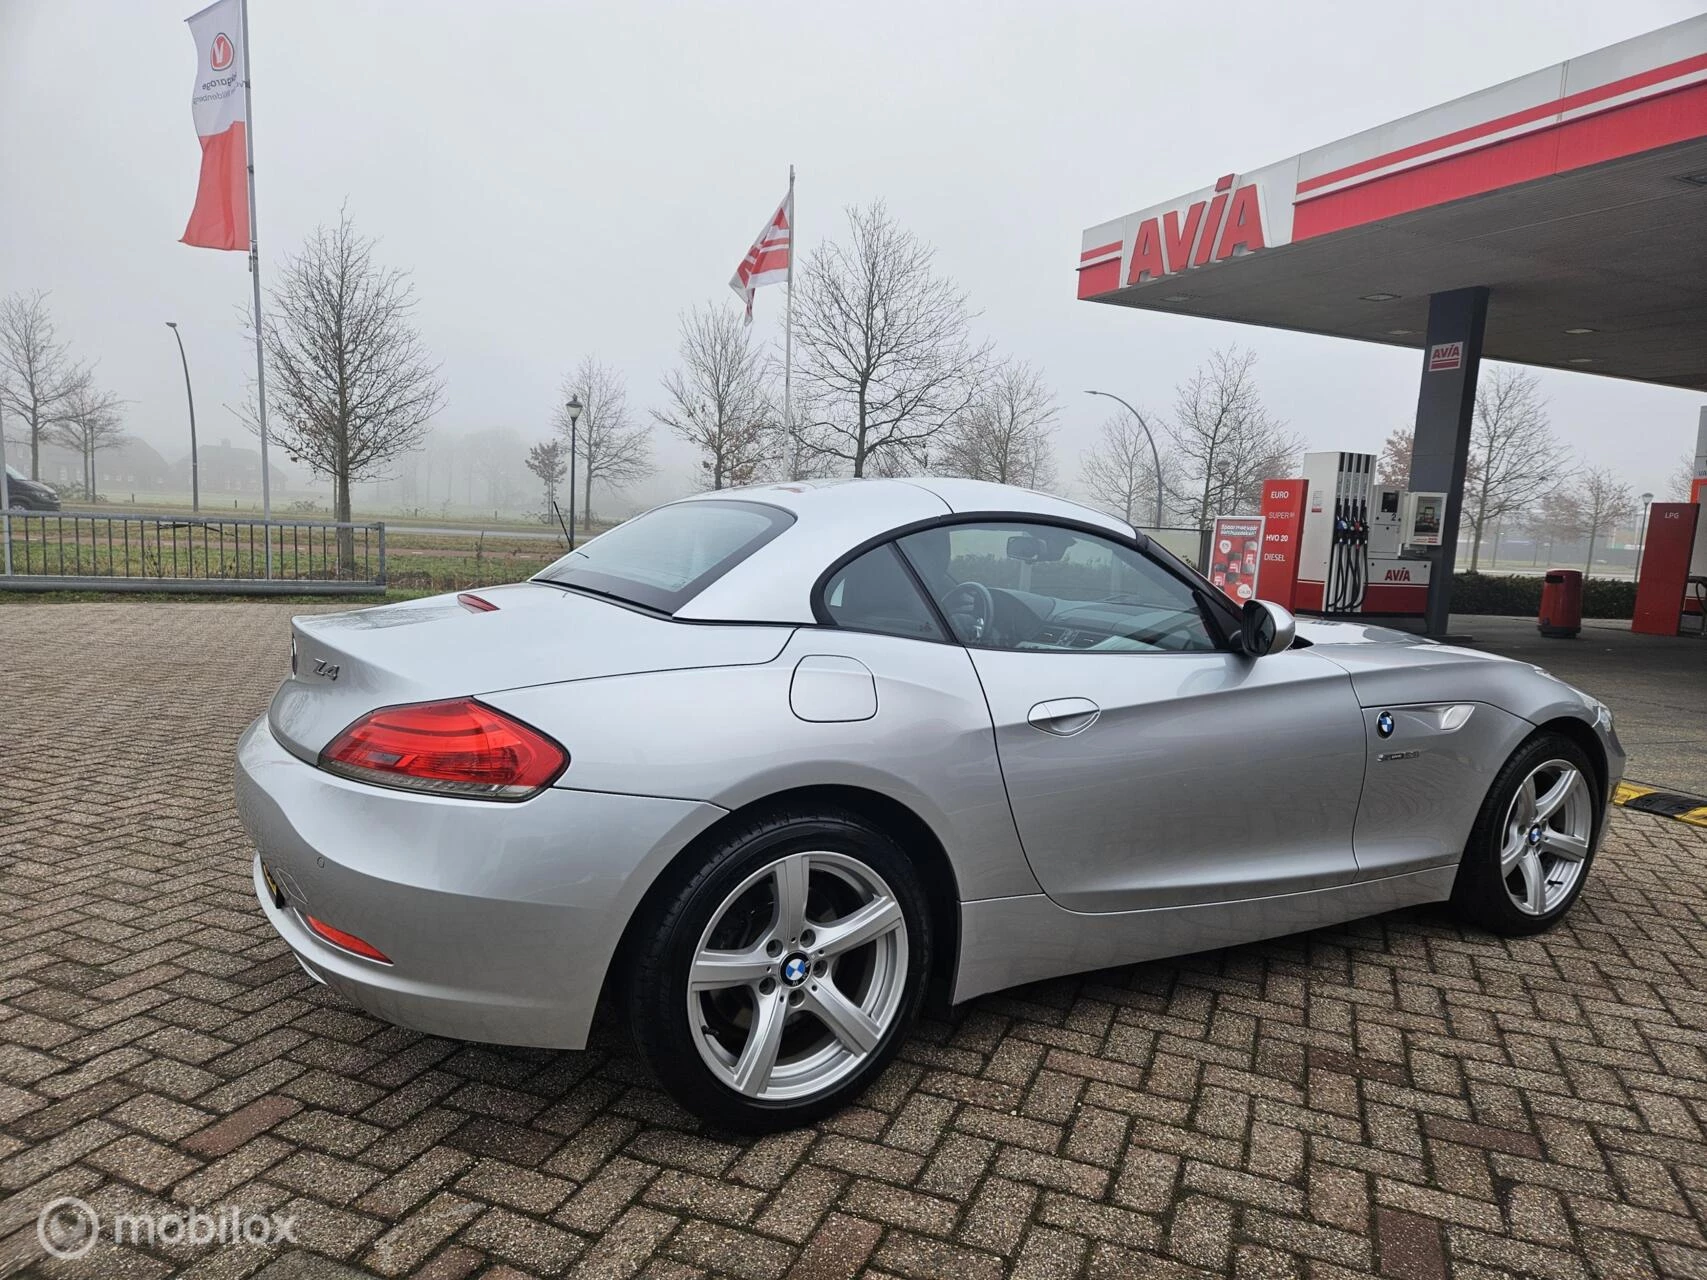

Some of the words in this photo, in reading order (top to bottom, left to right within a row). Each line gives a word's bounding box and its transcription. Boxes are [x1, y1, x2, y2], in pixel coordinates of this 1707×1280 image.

[1127, 173, 1265, 285] AVIA
[1432, 344, 1459, 359] AVIA
[1270, 491, 1289, 499] EURO
[1268, 511, 1289, 519] SUPER
[1391, 513, 1397, 521] 2
[1266, 534, 1280, 542] HVO
[1280, 534, 1289, 542] 20
[1264, 553, 1286, 562] DIESEL
[1385, 567, 1411, 582] AVIA
[313, 658, 340, 681] Z4
